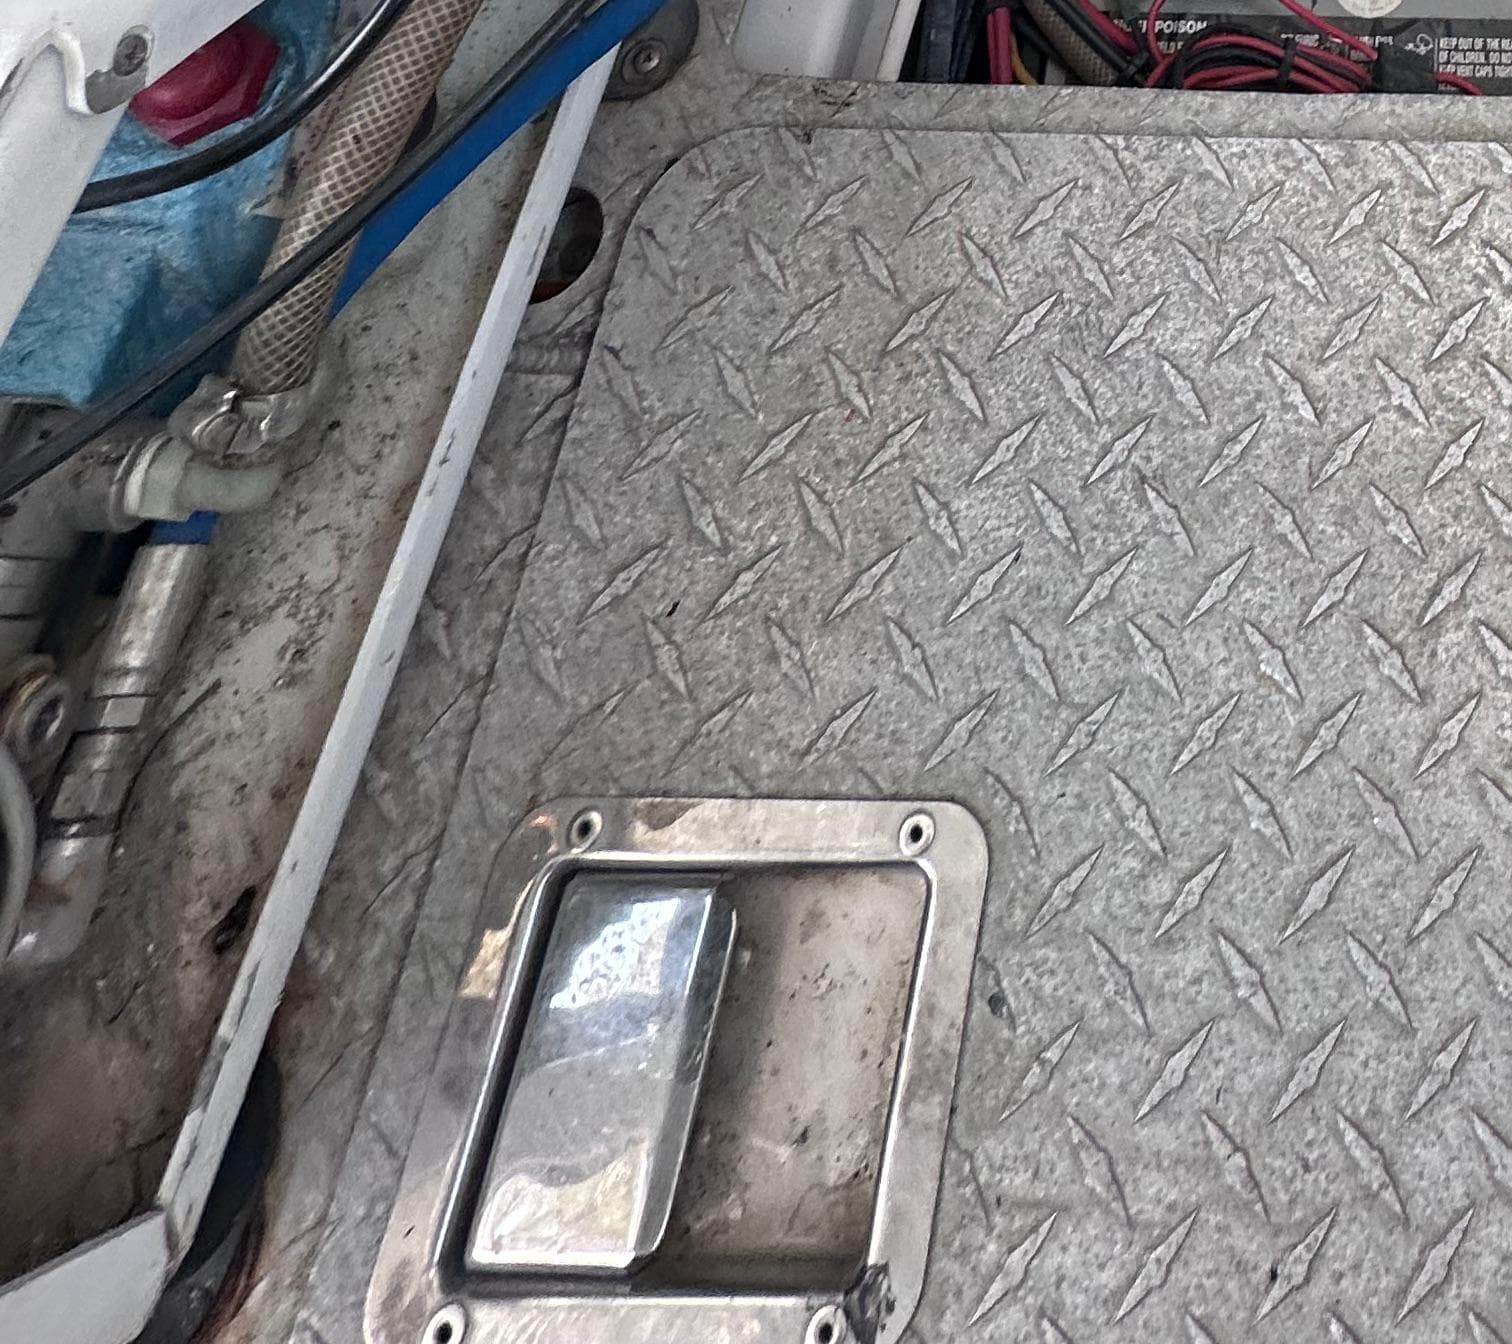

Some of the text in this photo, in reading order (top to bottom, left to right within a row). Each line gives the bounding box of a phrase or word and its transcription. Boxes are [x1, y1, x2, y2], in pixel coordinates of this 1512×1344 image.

[1439, 37, 1457, 49] KEEP
[1458, 37, 1473, 50] OUT
[1474, 38, 1485, 50] OF
[1486, 38, 1500, 50] THE
[1438, 51, 1448, 62] OF
[1488, 52, 1499, 63] DO
